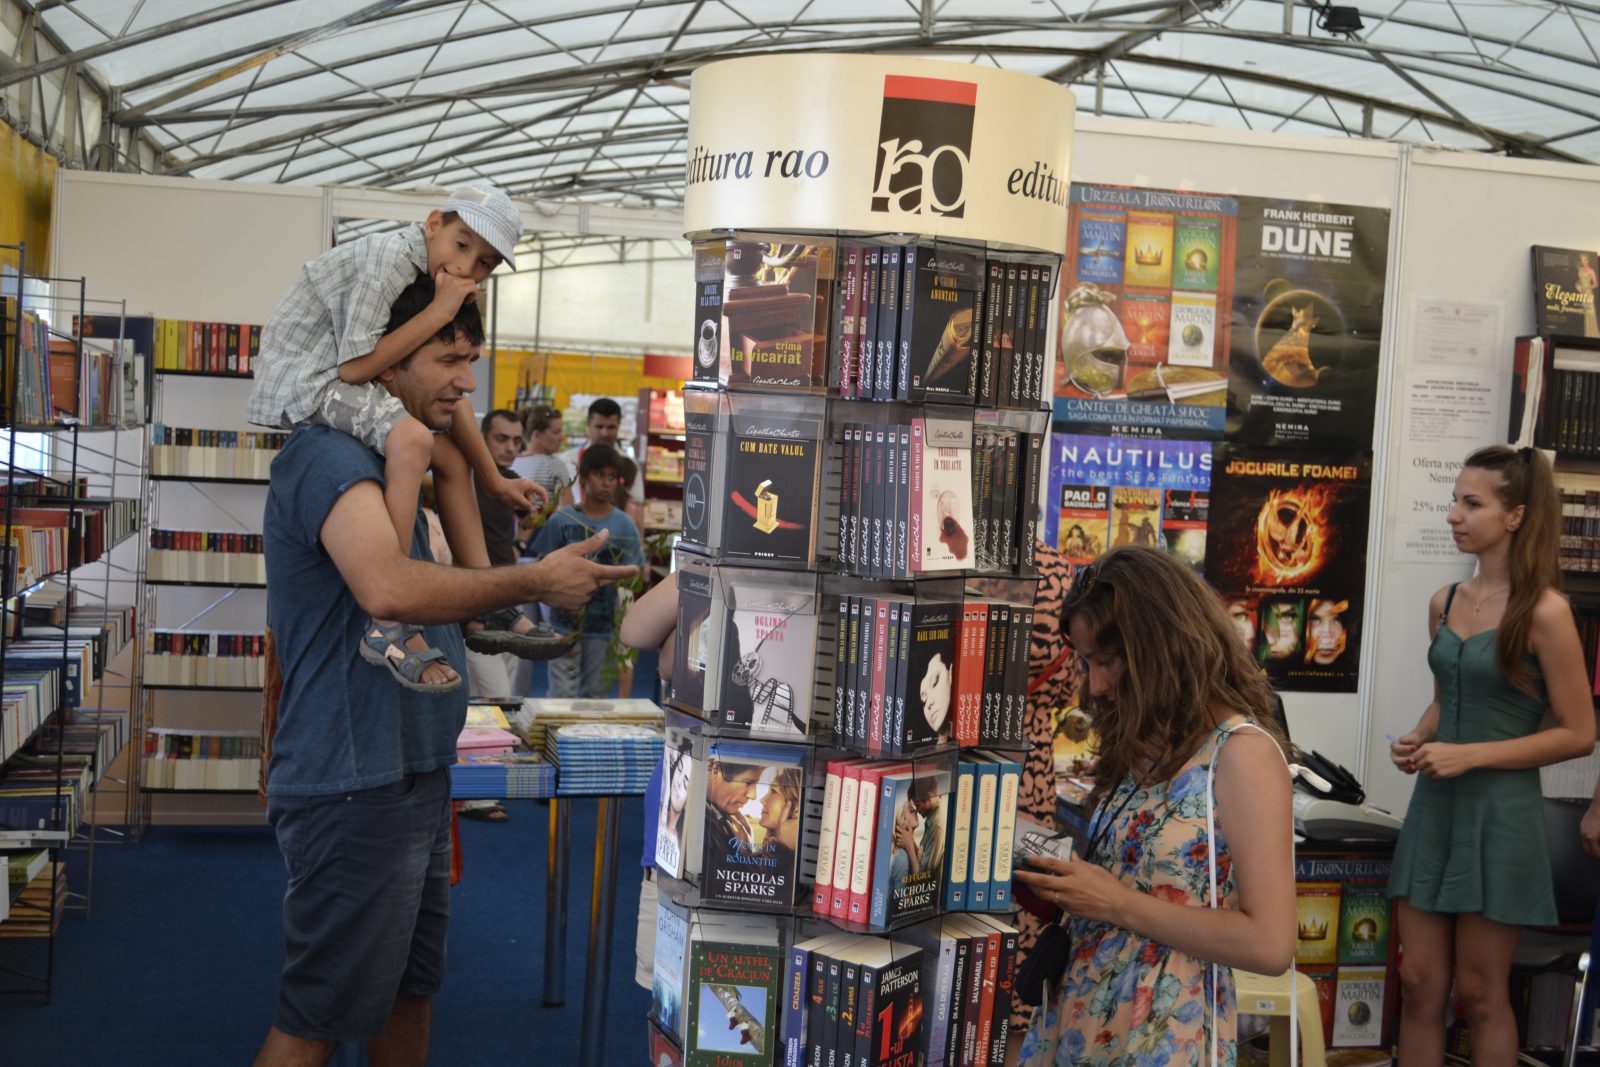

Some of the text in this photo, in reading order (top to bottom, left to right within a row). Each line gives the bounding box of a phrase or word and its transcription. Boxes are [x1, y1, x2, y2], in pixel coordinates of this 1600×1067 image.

[686, 145, 829, 188] editura rao
[871, 138, 971, 217] rao
[1007, 161, 1070, 210] editur
[1080, 186, 1222, 212] URZEALA TRONURILOR
[1263, 208, 1355, 226] FRANK HERBERT
[1082, 229, 1121, 242] MARTIN
[1261, 225, 1354, 258] DUNE
[775, 341, 802, 351] crima
[731, 347, 802, 365] la vicariat
[1067, 399, 1112, 414] CÂNTEC
[1115, 401, 1128, 414] DE
[1188, 407, 1211, 419] FOC
[1111, 425, 1162, 435] NEMIRA
[1275, 423, 1309, 431] NEMIRA
[740, 441, 756, 453] CUM
[758, 443, 778, 455] BATE
[1061, 445, 1212, 471] NAUTILUS
[1412, 457, 1442, 469] Oferta
[1061, 468, 1084, 478] the
[1090, 469, 1120, 480] best
[1125, 471, 1141, 481] SF
[1147, 472, 1156, 482] &
[1225, 461, 1358, 479] JOCURILE FOAMEI
[1064, 485, 1106, 503] PAOLO
[1412, 501, 1434, 512] 25%
[726, 854, 777, 867] RODANTHE
[820, 845, 830, 876] SPARKS
[838, 849, 848, 880] SPARKS
[957, 842, 966, 874] SPARKS
[979, 842, 988, 874] SPARKS
[1001, 842, 1009, 873] SPARKS
[716, 869, 785, 886] NICHOLAS
[856, 853, 865, 885] SPARKS
[724, 881, 775, 897] SPARKS
[893, 880, 937, 899] NICHOLAS
[898, 892, 931, 910] SPARKS
[1346, 906, 1386, 917] MARTIN
[708, 951, 728, 964] UN
[699, 965, 713, 977] DE
[881, 966, 903, 985] JAMES
[792, 971, 801, 1010] CROAZIERA
[880, 970, 919, 996] PATTERSON
[940, 984, 948, 992] PE
[812, 995, 823, 1004] 4
[940, 993, 947, 1002] DE
[1340, 989, 1381, 1001] MARTIN
[938, 1003, 946, 1020] CASA
[964, 1021, 972, 1049] PATTERSON
[972, 960, 982, 1003] SALVAMARUL
[950, 1023, 958, 1051] PATTERSON
[981, 1020, 990, 1064] PATTERSON
[998, 1019, 1008, 1063] PATTERSON
[974, 1041, 982, 1064] JAMES
[992, 1039, 1000, 1063] JAMES
